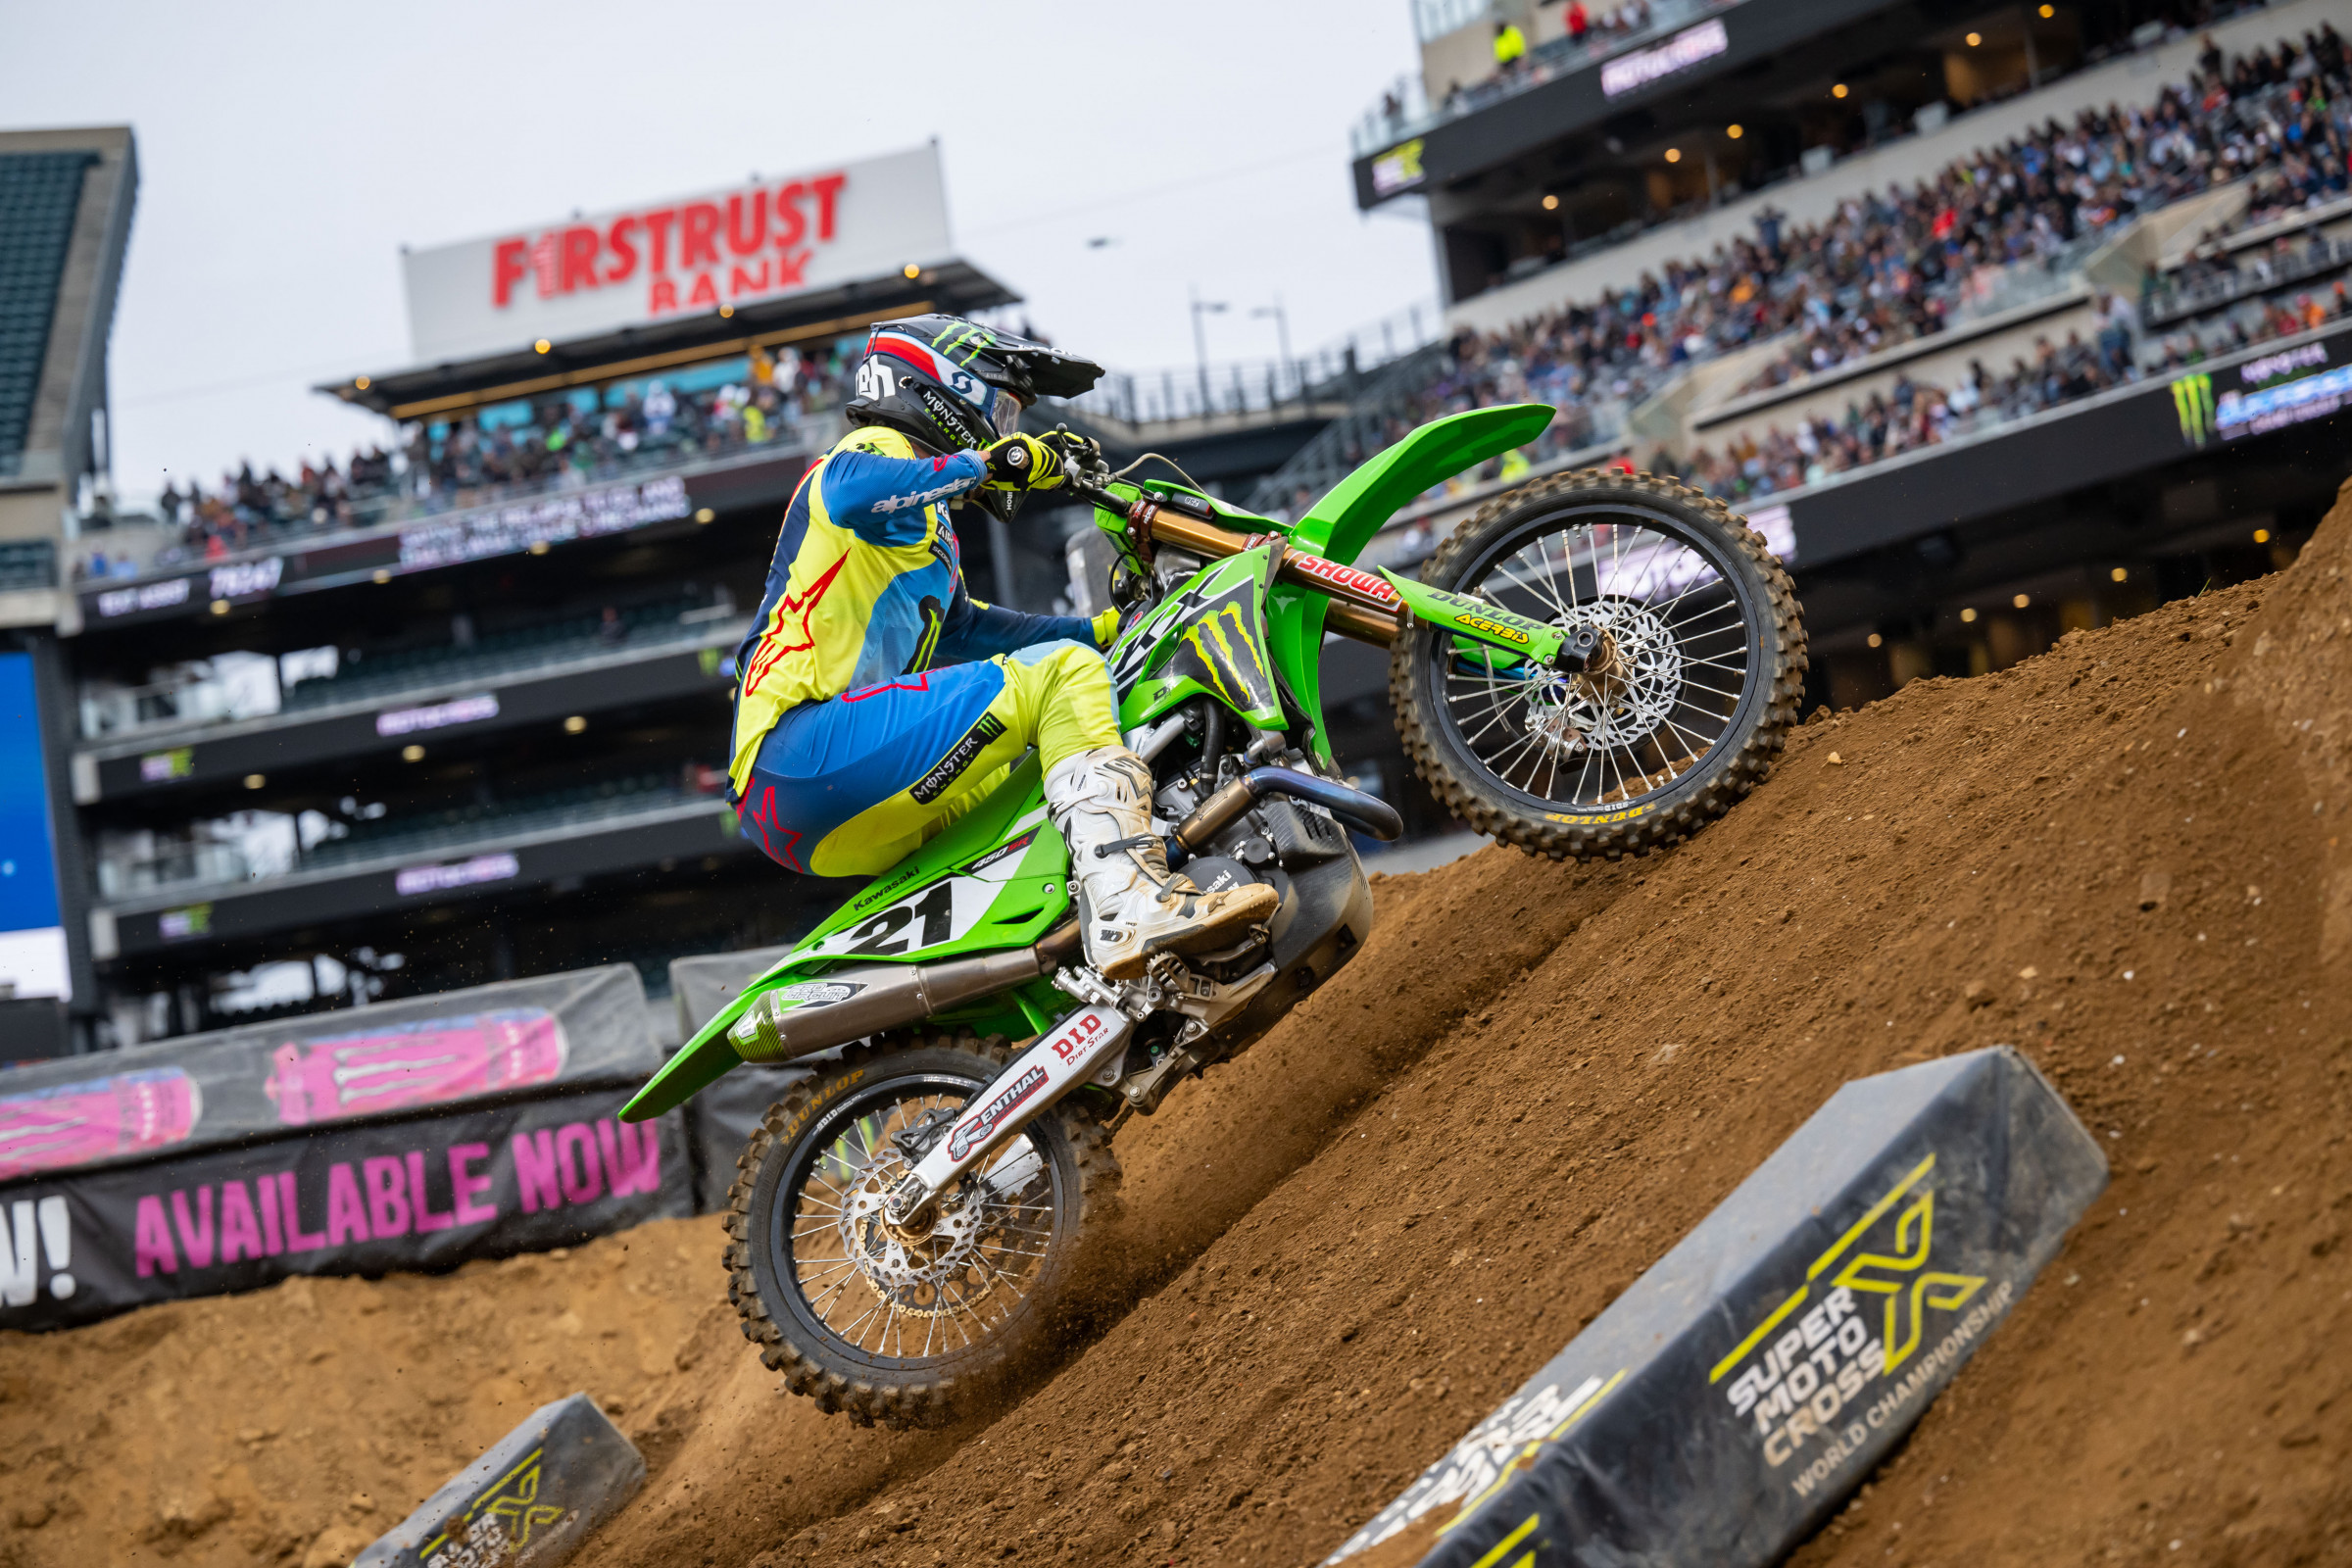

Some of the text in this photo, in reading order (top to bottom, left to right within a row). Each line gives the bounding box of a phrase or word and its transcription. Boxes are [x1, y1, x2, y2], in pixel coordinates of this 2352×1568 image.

[923, 390, 978, 451] MONSTER
[924, 408, 963, 447] ENERGY
[1297, 555, 1397, 602] SHOWA
[1427, 590, 1544, 632] DUNLOP
[913, 736, 978, 799] MONSTER
[932, 754, 974, 796] ENERGY
[1545, 805, 1644, 824] DUNLOP
[971, 836, 1030, 870] 450SR
[845, 880, 953, 956] 21
[853, 865, 920, 911] Kawasaki
[787, 1069, 864, 1139] DUNLOP
[134, 1115, 662, 1278] AVAILABLE NOW
[1727, 1285, 1857, 1417] SUPER
[1753, 1315, 1868, 1436] MOTO
[1763, 1338, 1887, 1468] CROSS
[1790, 1280, 2014, 1497] WORLD CHAMPIONSHIP
